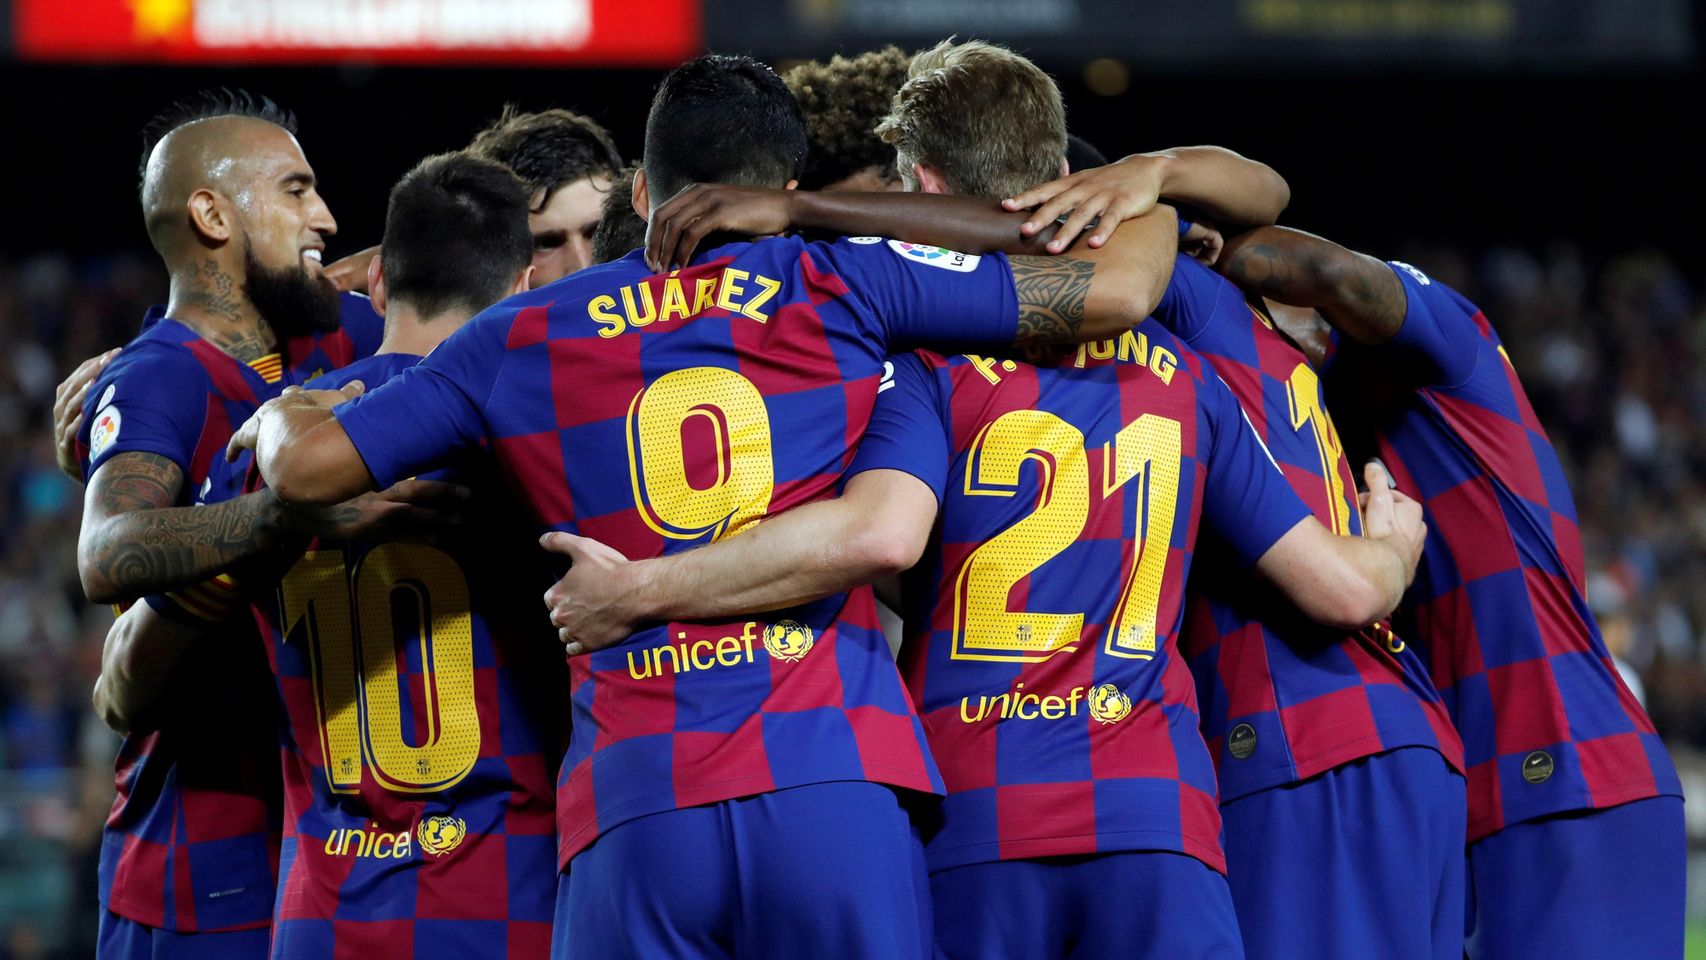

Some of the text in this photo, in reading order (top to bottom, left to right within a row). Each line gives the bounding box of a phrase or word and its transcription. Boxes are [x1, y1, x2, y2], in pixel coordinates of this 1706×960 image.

[587, 267, 782, 339] SUÁREZ
[625, 366, 775, 545] 9
[950, 409, 1182, 664] 21
[276, 542, 481, 795] 10
[627, 622, 757, 680] unicef
[960, 682, 1084, 723] unicef
[324, 821, 413, 859] unice
